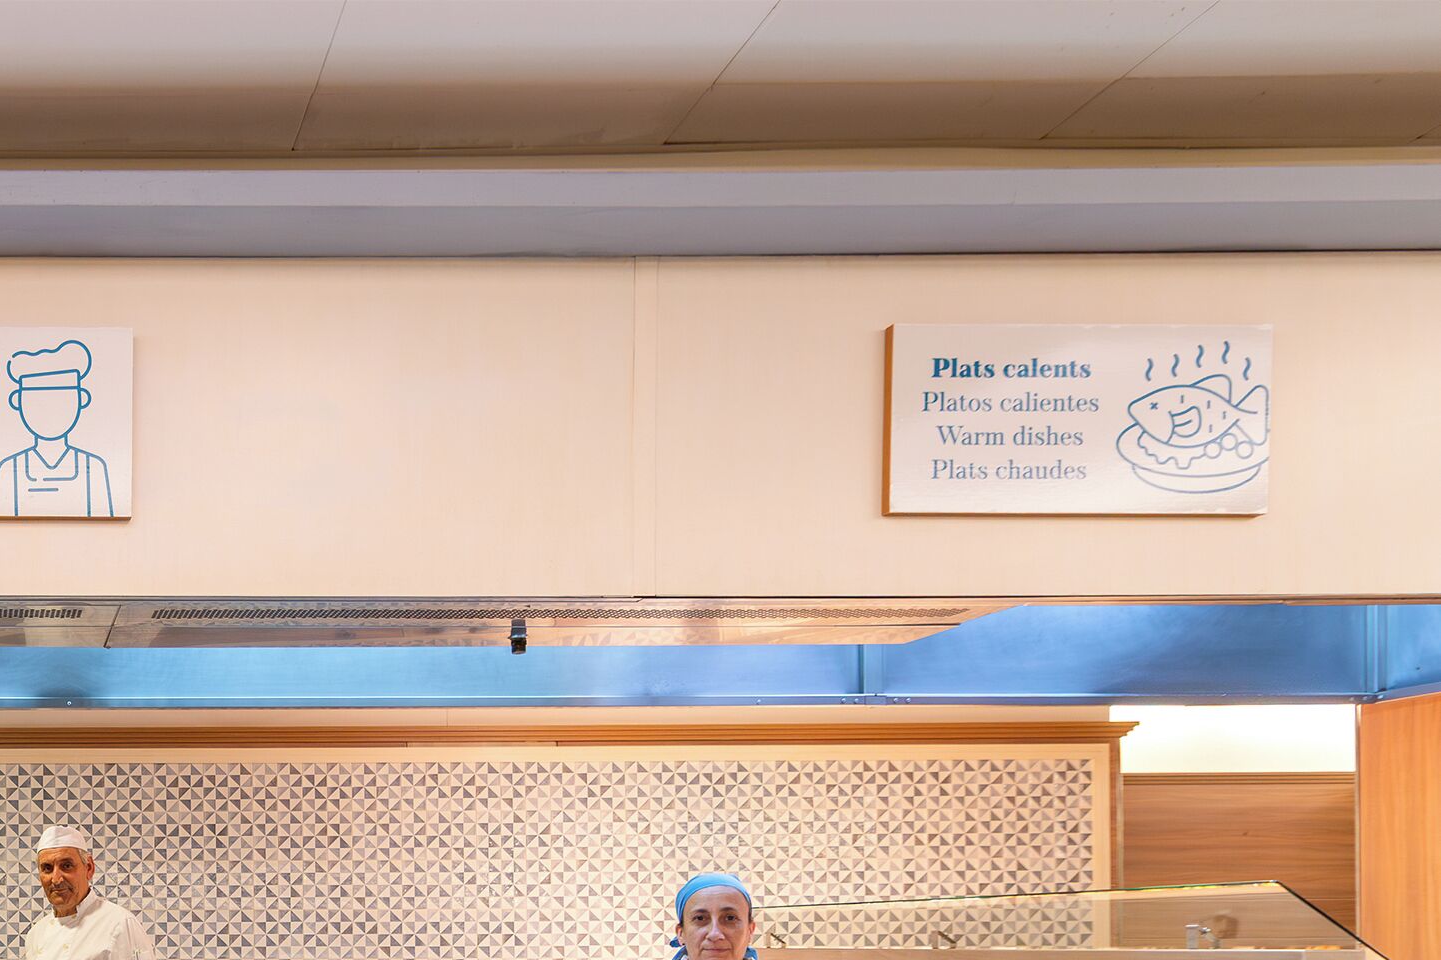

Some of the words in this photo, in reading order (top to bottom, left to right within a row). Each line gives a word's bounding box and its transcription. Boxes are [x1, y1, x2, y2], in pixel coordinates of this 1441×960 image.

[931, 357, 995, 379] Plats
[1002, 357, 1092, 379] calents
[921, 391, 992, 413] Platos
[998, 391, 1099, 413] calientes
[936, 425, 1005, 446] Warm
[1012, 424, 1084, 446] dishes
[931, 459, 988, 480] Plats
[995, 458, 1087, 480] chaudes
